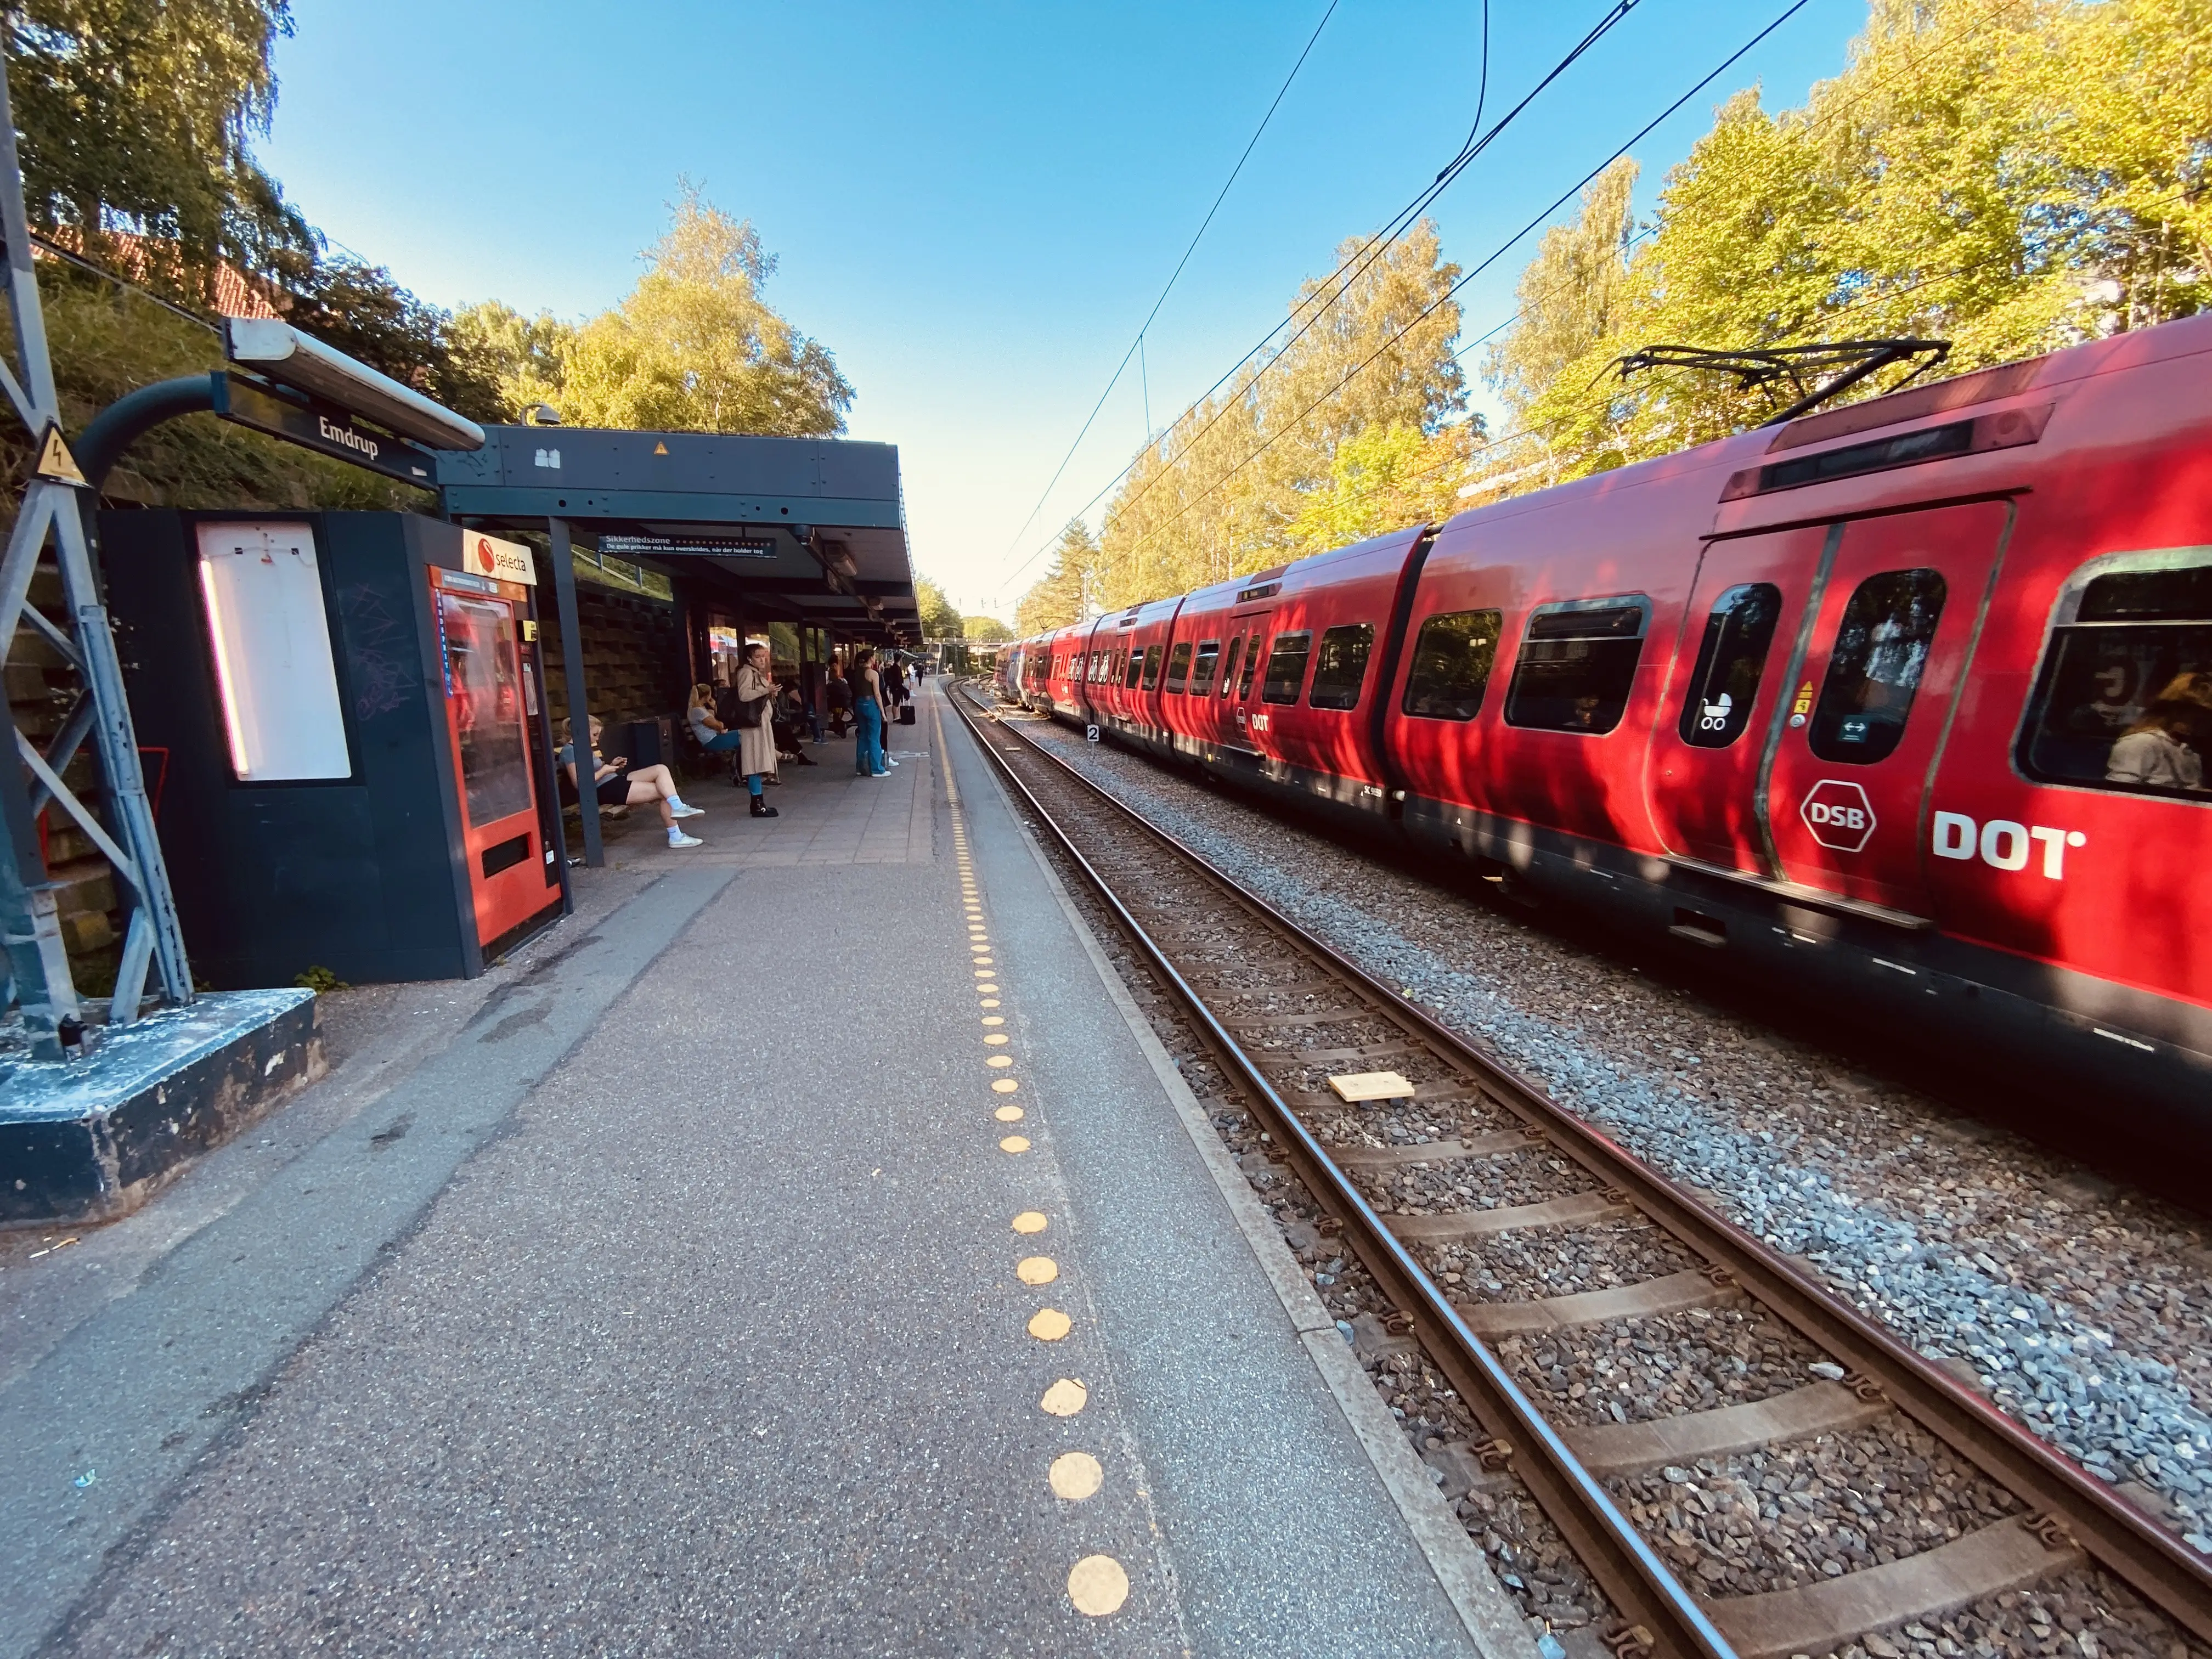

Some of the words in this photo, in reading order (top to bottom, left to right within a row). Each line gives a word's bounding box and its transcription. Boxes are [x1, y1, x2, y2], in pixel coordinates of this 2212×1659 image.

[319, 415, 379, 460] Emdrup
[606, 535, 671, 544] Sikkerhedszone
[496, 552, 527, 572] selecta
[1252, 713, 1269, 732] DOT
[1088, 727, 1098, 740] 2
[1810, 803, 1865, 831] DSB
[1932, 810, 2086, 880] DOT
